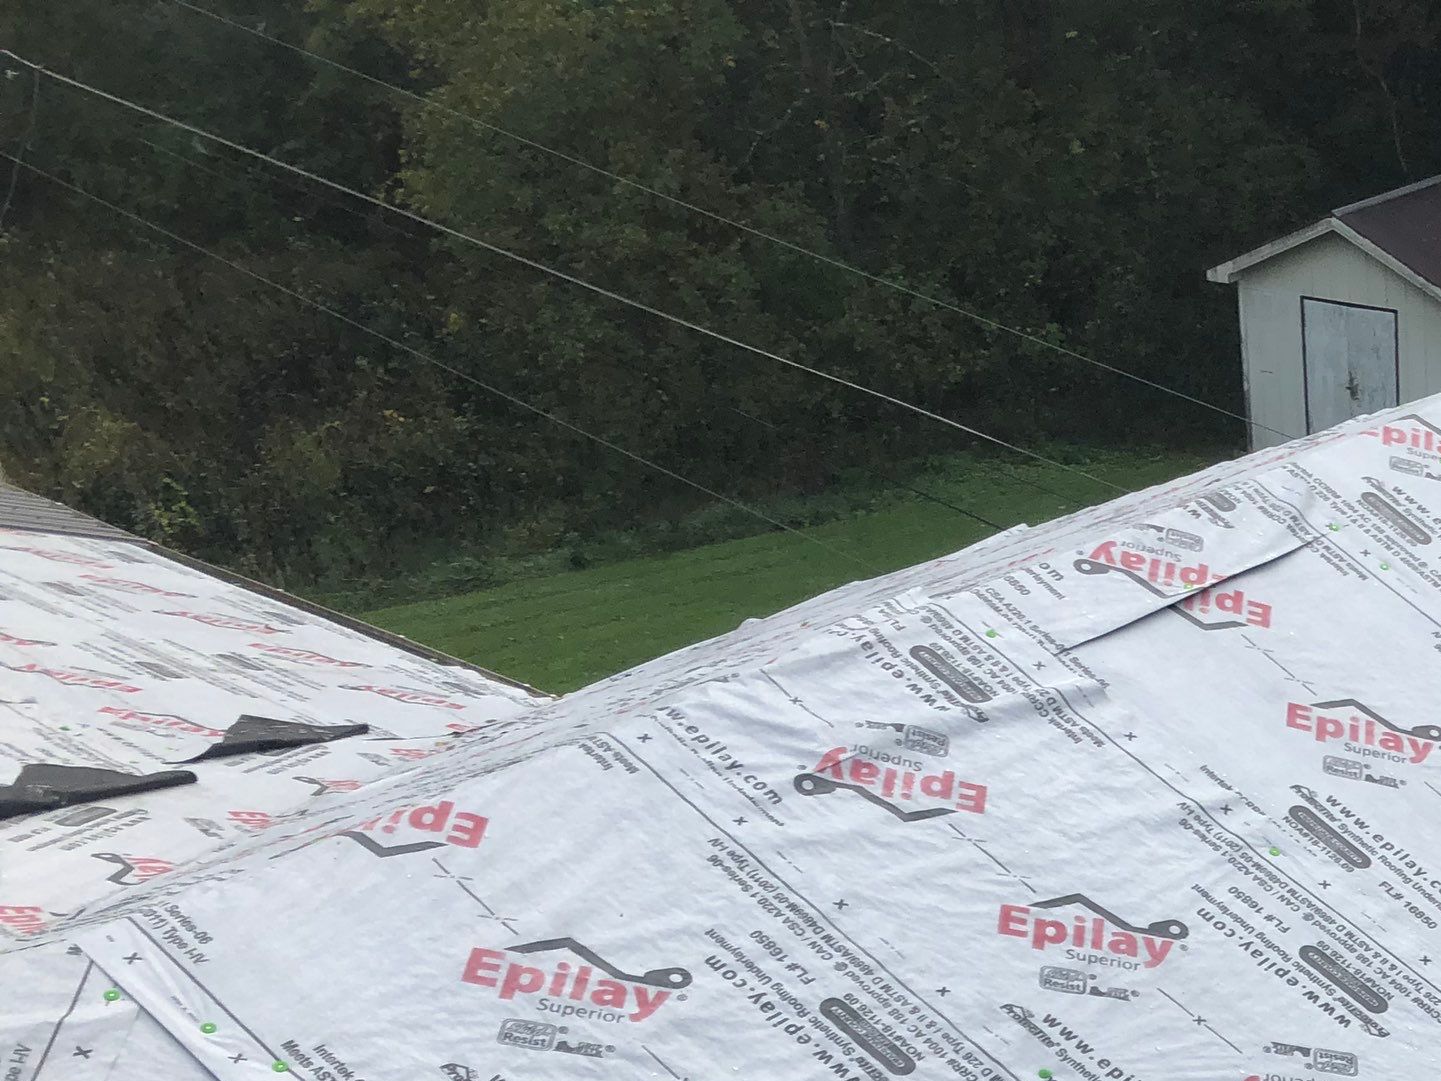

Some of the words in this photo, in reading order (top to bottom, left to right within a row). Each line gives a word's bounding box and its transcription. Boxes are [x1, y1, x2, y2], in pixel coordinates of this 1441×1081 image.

[1120, 541, 1182, 562] Superior
[1286, 702, 1434, 764] Epilay
[852, 742, 923, 772] Superior
[1343, 741, 1406, 765] Superior
[816, 746, 988, 815] Epilay
[1229, 885, 1260, 910] 16850
[1379, 881, 1403, 900] FL#
[1403, 902, 1438, 930] 16850
[997, 903, 1174, 968] Epilay
[1262, 909, 1291, 934] FL#
[750, 930, 789, 963] 16850
[1065, 948, 1141, 971] Superior
[785, 963, 816, 985] FL#
[1196, 907, 1351, 1028] www.epilay.com
[461, 946, 672, 1022] Epilay
[536, 997, 626, 1023] Superior
